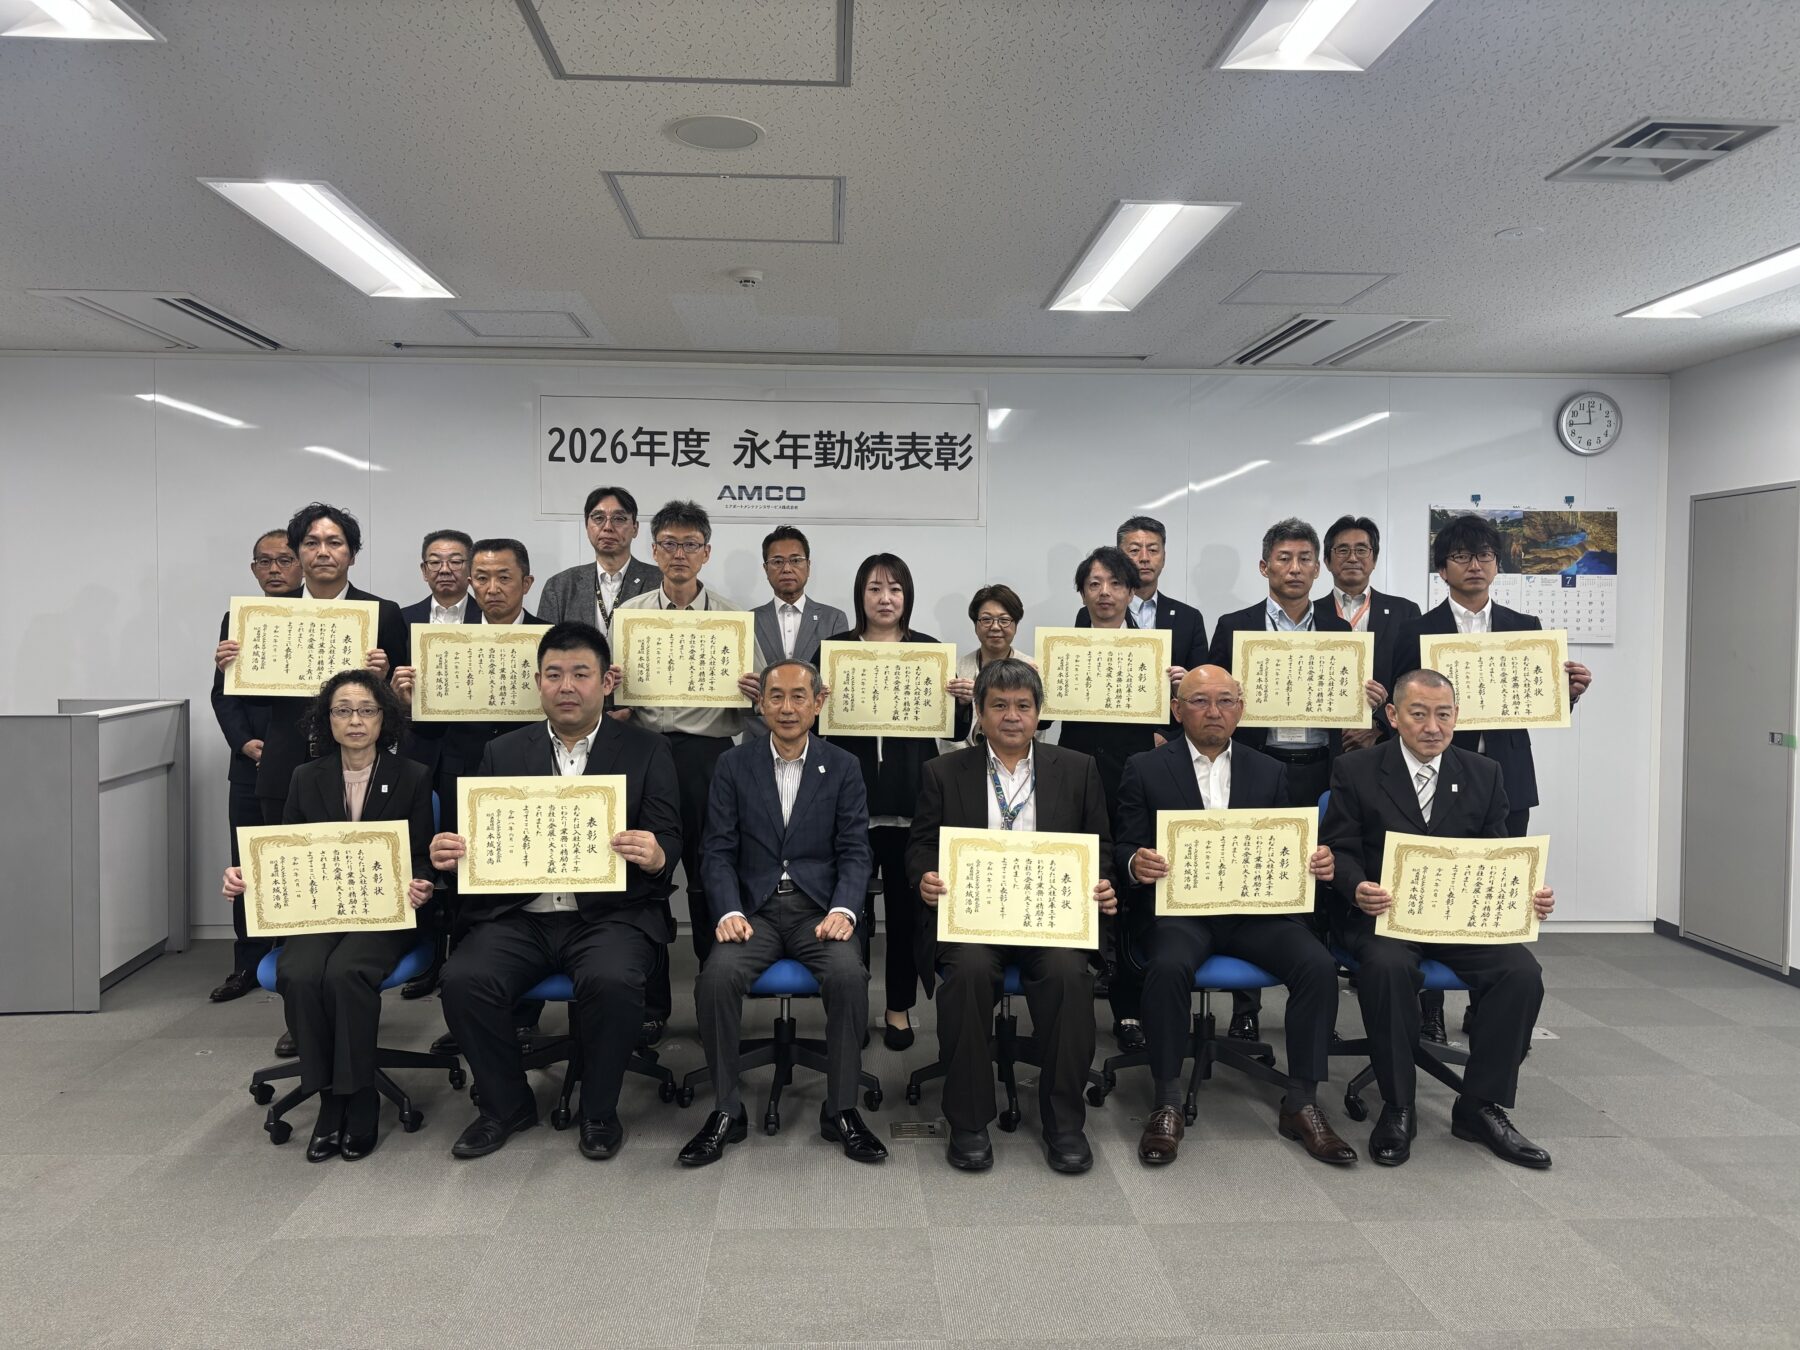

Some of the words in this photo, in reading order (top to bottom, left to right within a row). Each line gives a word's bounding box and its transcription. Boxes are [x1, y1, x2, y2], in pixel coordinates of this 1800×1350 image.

[548, 426, 710, 467] 2026年度
[732, 429, 973, 471] 永年勤続表彰
[717, 485, 806, 501] AMCO
[342, 634, 352, 665] 表彰状
[721, 646, 730, 676] 表彰状
[522, 660, 530, 690] 表彰状
[1138, 662, 1147, 692] 表彰状
[1339, 666, 1349, 696] 表彰状
[1534, 665, 1544, 696] 表彰状
[923, 677, 932, 707] 表彰状
[586, 816, 597, 854] 表彰状
[371, 861, 384, 896] 表彰状
[1279, 846, 1290, 880] 表彰状
[1061, 873, 1072, 910] 表彰状
[1507, 876, 1520, 910] 表彰状
